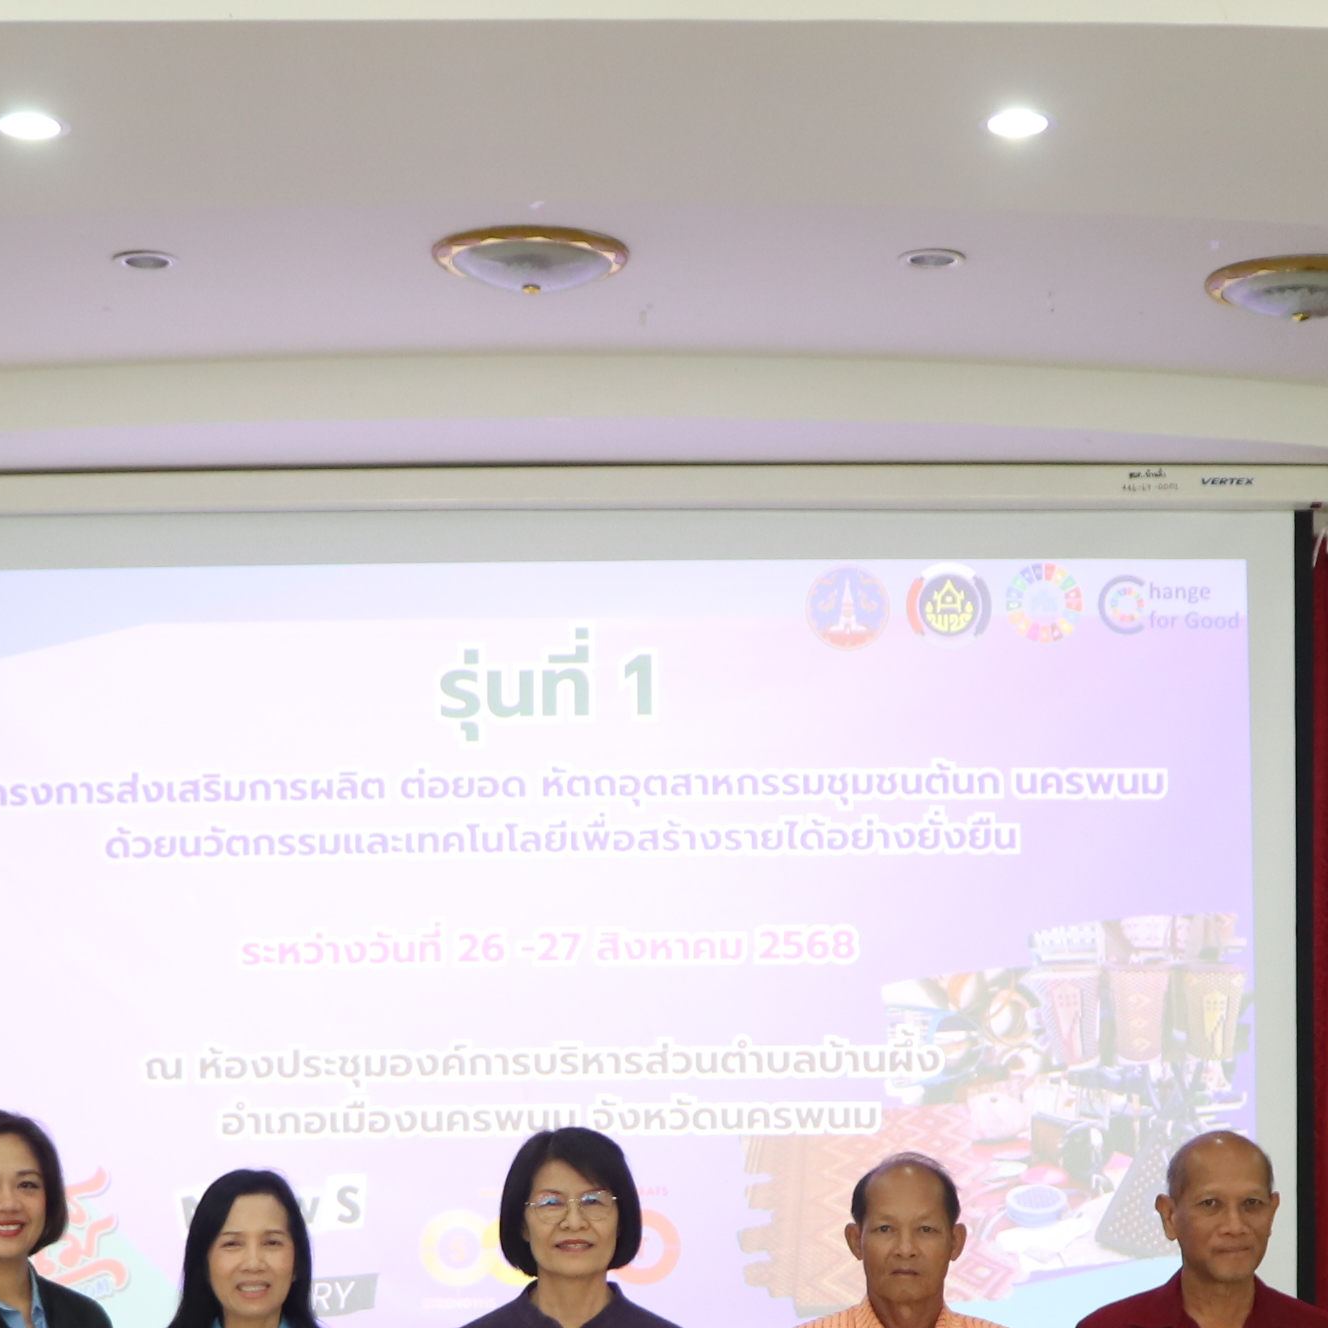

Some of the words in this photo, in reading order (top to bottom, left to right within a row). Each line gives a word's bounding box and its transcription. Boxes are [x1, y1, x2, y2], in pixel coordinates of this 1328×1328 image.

[1201, 477, 1255, 485] VERTEX
[1149, 611, 1180, 629] for
[1185, 611, 1240, 630] Good
[439, 627, 590, 742] รุ่นที่
[623, 653, 653, 716] 1
[399, 768, 526, 801] ต่อยอด
[543, 764, 1000, 807] หัตถอุตสาหกรรมชุมชนต้นก
[1015, 768, 1165, 797] นครพนม
[105, 810, 1017, 859] ด้วยนวัตกรรมและเทคโนโลยีเพื่อสร้างรายได้อย่างยั่งยืน
[241, 921, 442, 966] ระหว่างวันที่
[458, 933, 505, 963] 26
[521, 932, 583, 963] -27
[597, 931, 742, 962] สิงหาคม
[758, 930, 856, 961] 2568
[146, 1053, 183, 1081] ณ
[200, 1030, 941, 1088] ห้องประชุมองค์การบริหารส่วนตำบลบ้านผึ้ง
[221, 1101, 576, 1135] อำเภอเมืองนครพนม
[593, 1098, 878, 1131] จังหวัดนครพนม
